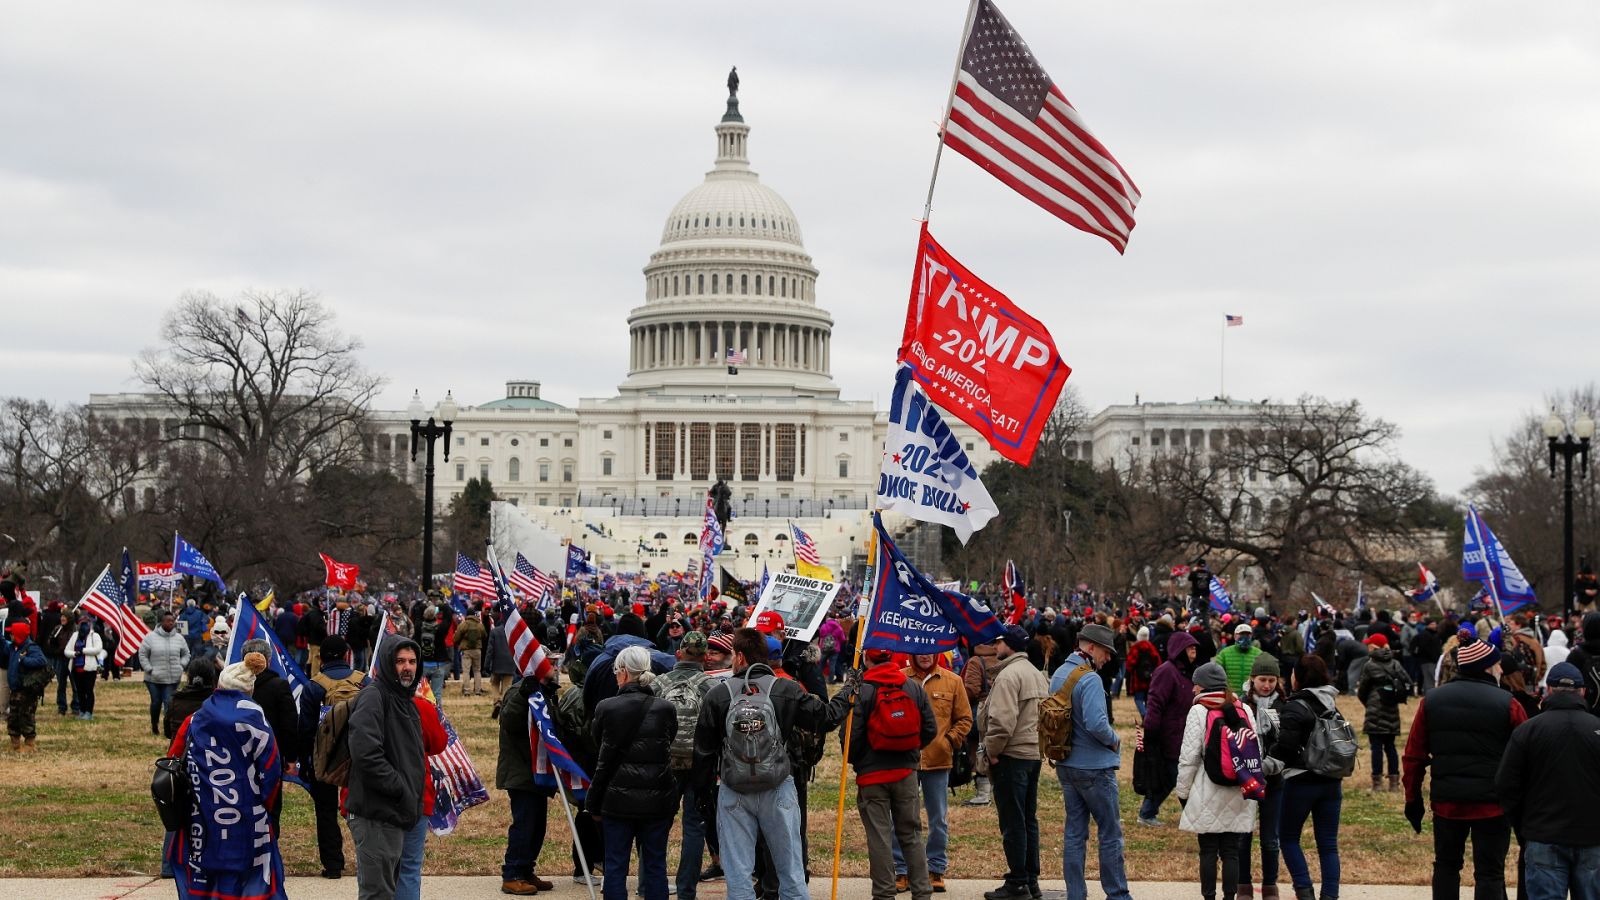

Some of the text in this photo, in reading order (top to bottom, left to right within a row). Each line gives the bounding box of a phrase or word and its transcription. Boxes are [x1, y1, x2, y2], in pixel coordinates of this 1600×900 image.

[936, 364, 991, 408] AMERICA
[901, 443, 948, 484] 202
[774, 574, 833, 591] NOTHING TO
[784, 627, 799, 638] ERE
[205, 736, 241, 840] -2020-
